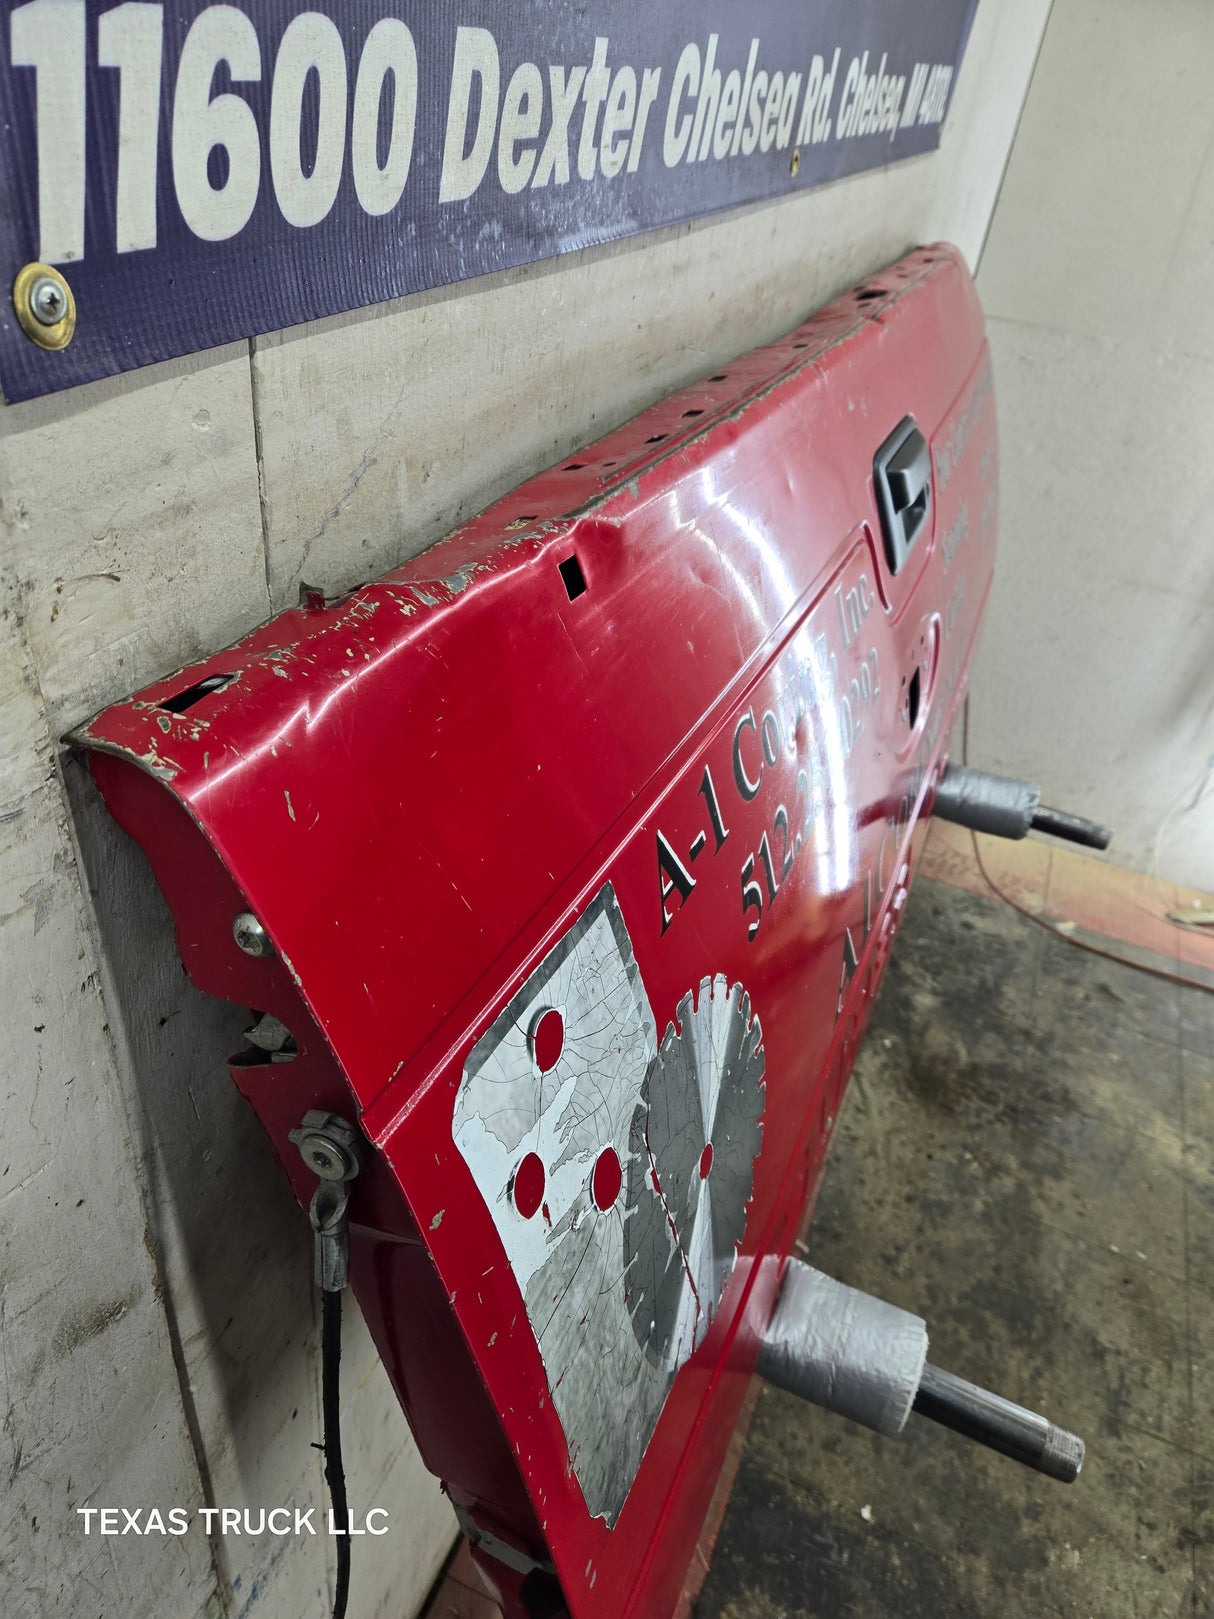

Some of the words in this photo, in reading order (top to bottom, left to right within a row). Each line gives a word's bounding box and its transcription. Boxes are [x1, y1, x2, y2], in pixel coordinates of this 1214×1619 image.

[10, 0, 418, 265] 11600
[439, 26, 661, 204] Dexter
[663, 33, 802, 169] Chelsea
[796, 47, 841, 146] Rd.
[836, 50, 906, 144] Chelsea,
[659, 764, 729, 937] A-1
[834, 573, 875, 652] Inc.
